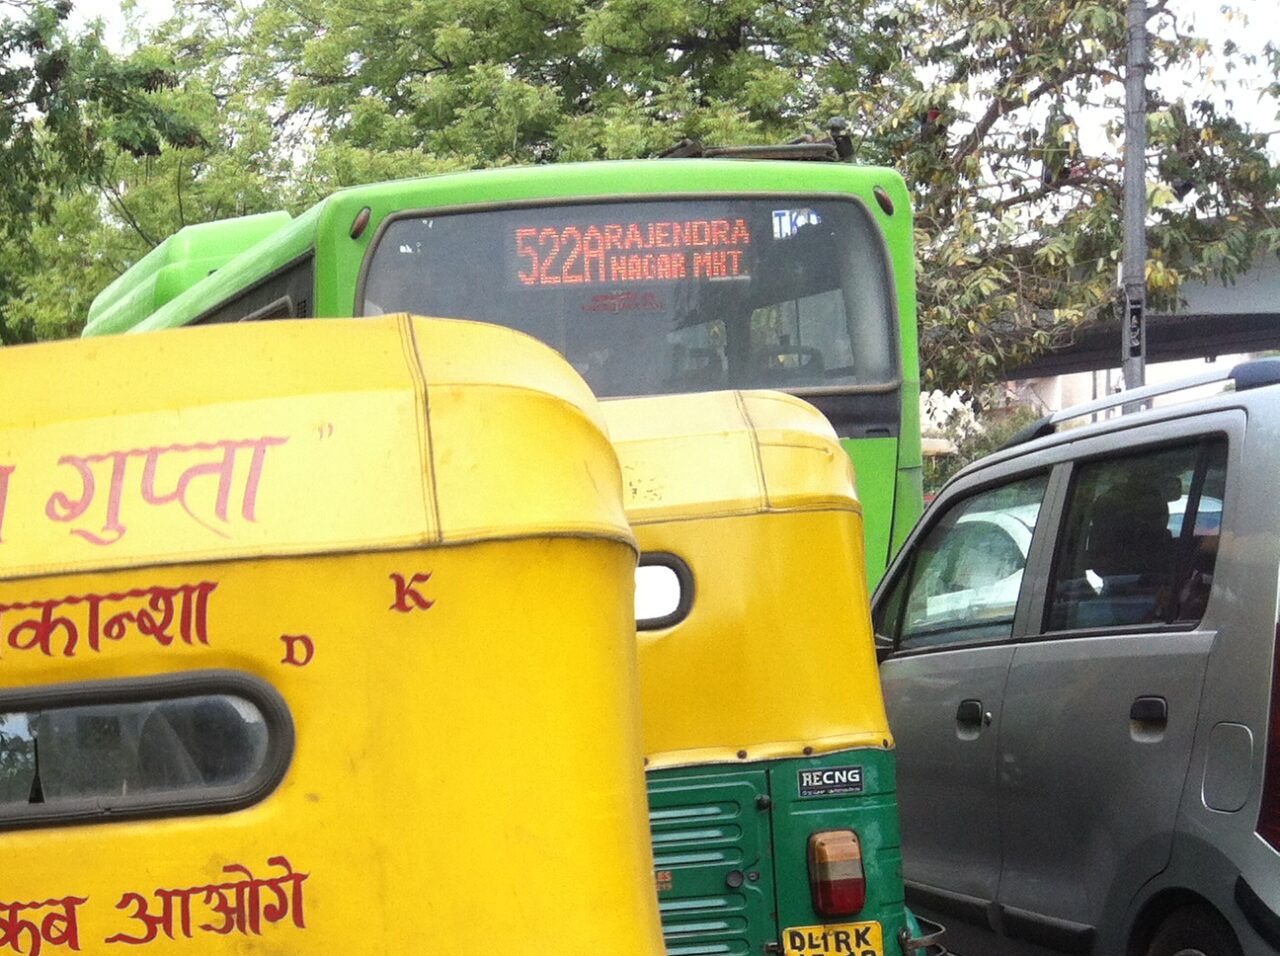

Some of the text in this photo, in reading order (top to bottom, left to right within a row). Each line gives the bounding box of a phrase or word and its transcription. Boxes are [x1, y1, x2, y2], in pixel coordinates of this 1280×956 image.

[605, 218, 751, 250] RAJENDRA
[515, 224, 606, 286] 522A
[388, 572, 436, 613] K
[279, 633, 315, 669] D
[104, 855, 310, 945] आओगे
